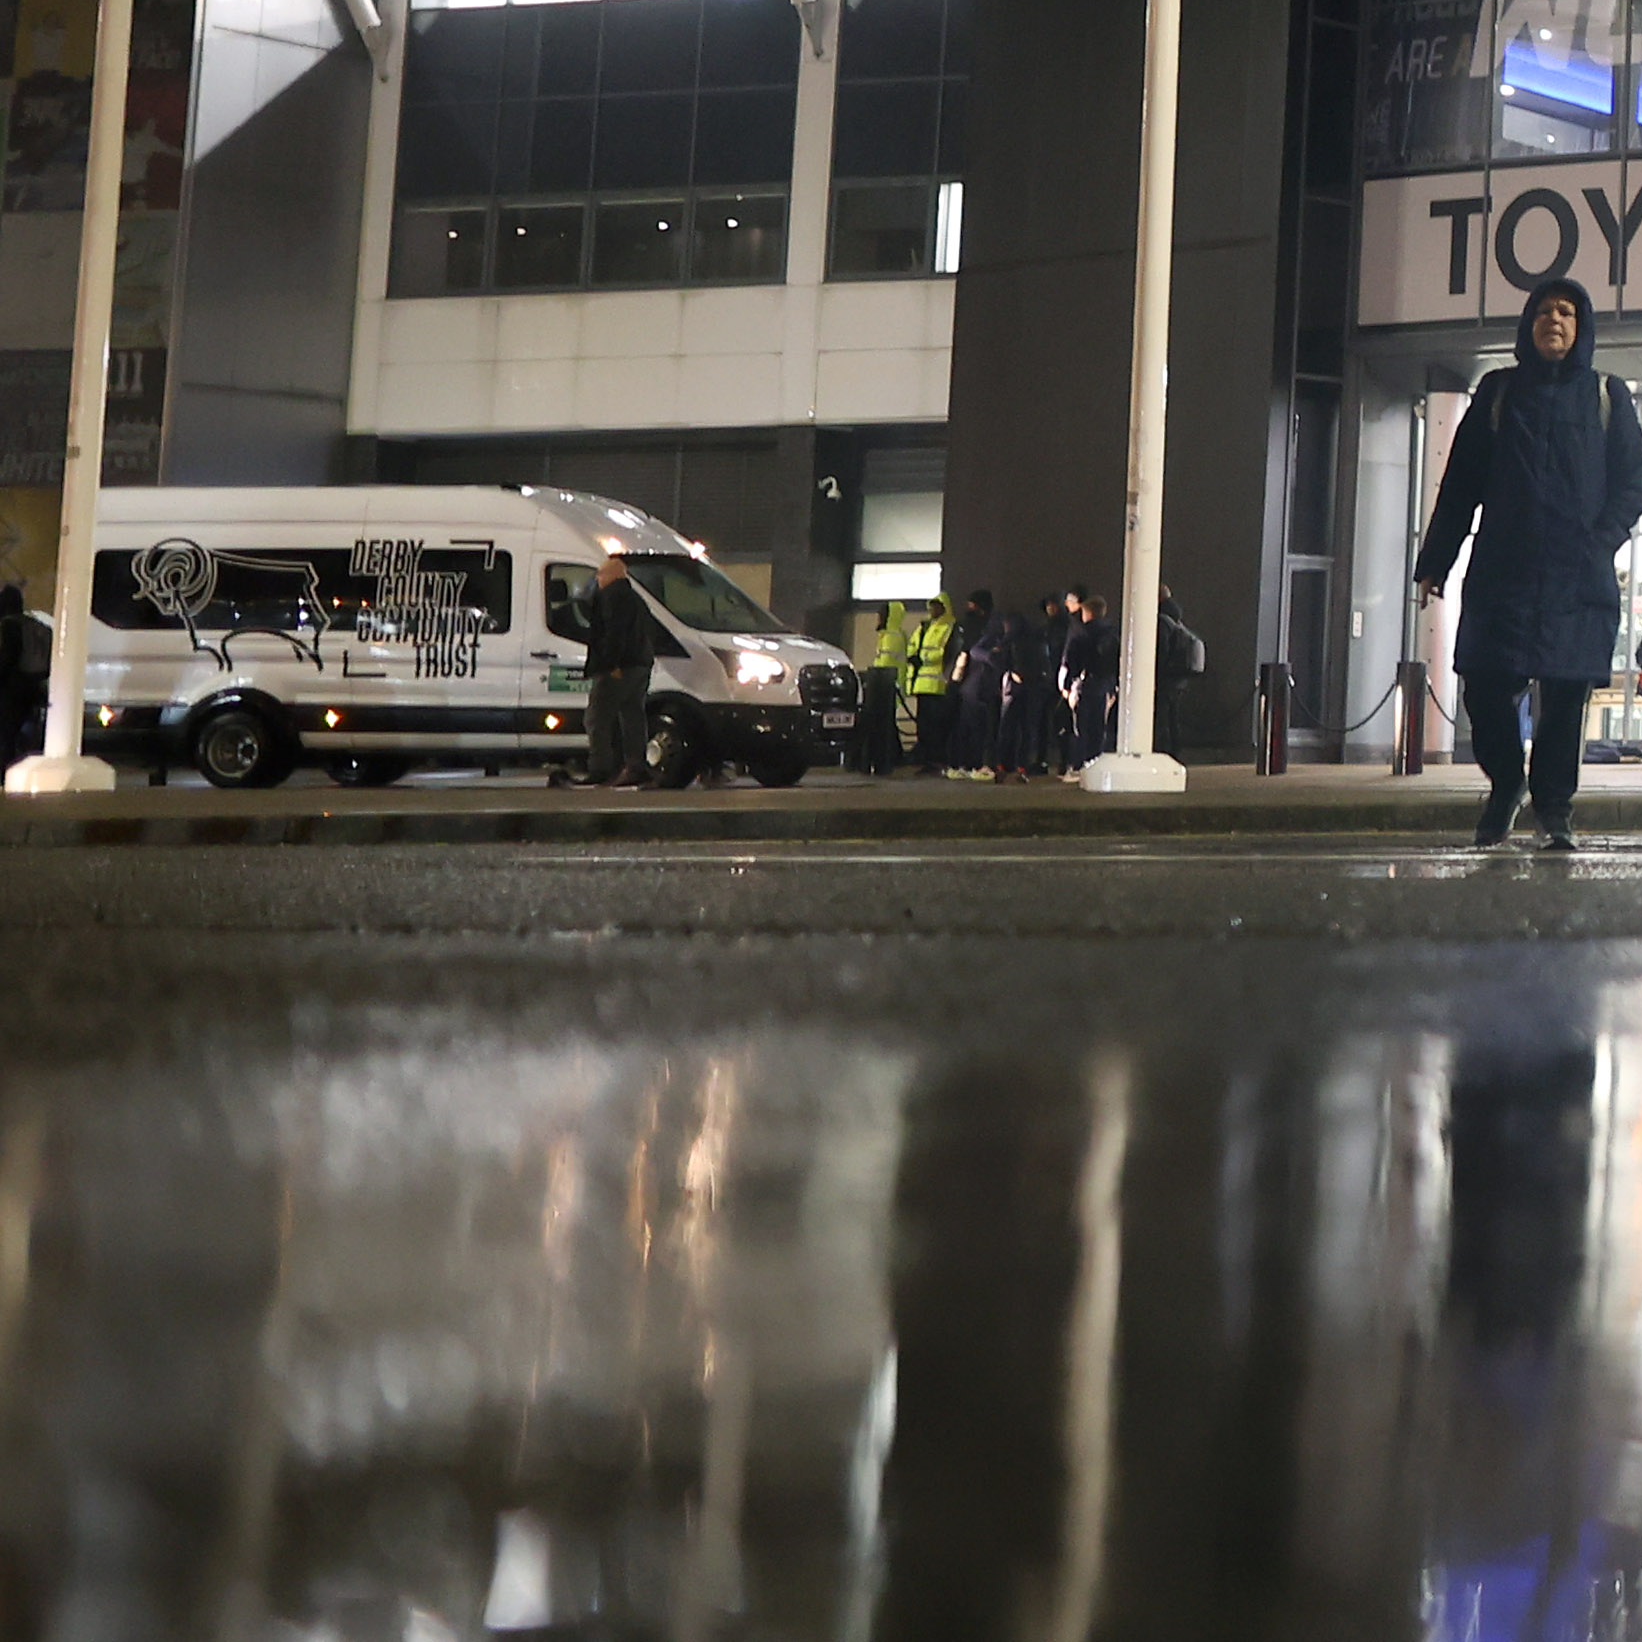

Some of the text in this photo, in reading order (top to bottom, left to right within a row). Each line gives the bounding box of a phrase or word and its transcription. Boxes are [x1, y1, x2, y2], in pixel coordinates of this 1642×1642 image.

[1384, 36, 1448, 85] ARE
[350, 539, 424, 576] DERBY
[377, 571, 467, 609] COUNTY
[415, 642, 481, 679] TRUST
